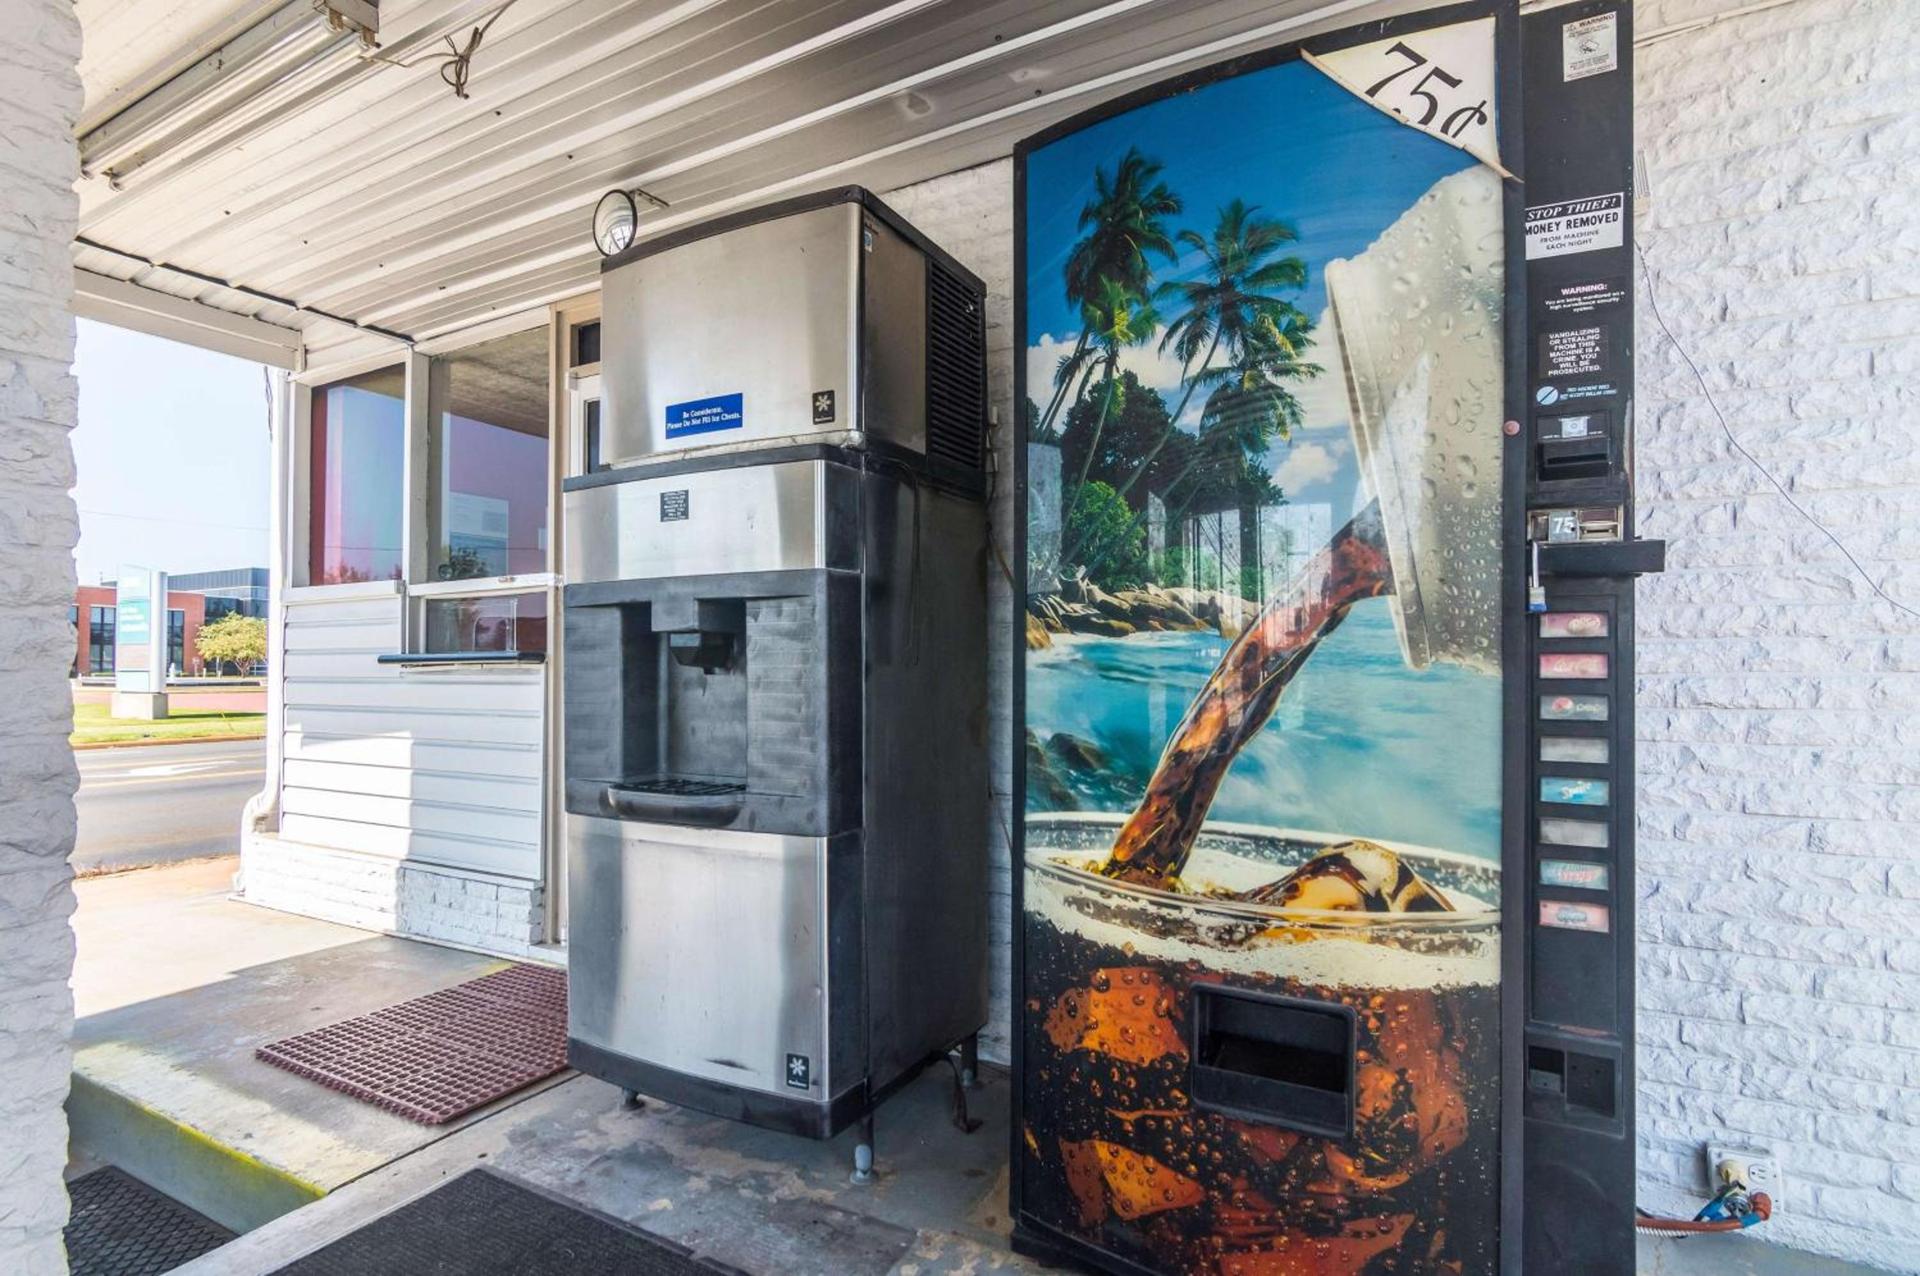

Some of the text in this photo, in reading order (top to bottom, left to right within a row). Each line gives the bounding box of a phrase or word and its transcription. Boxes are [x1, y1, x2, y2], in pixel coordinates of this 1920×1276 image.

[1527, 198, 1617, 221] STOP THIEF!
[1526, 212, 1619, 235] MONEY REMOVED
[1541, 230, 1600, 243] FROM MACHINE
[1568, 238, 1593, 247] NIGHT
[1549, 327, 1600, 339] VANDALIZING
[1549, 333, 1600, 346] OR STEALING
[1554, 340, 1595, 351] FROM THIS
[1550, 347, 1584, 358] MACHINE
[1581, 352, 1597, 360] YOU
[1559, 359, 1590, 369] WILL BE
[1553, 517, 1575, 534] 75
